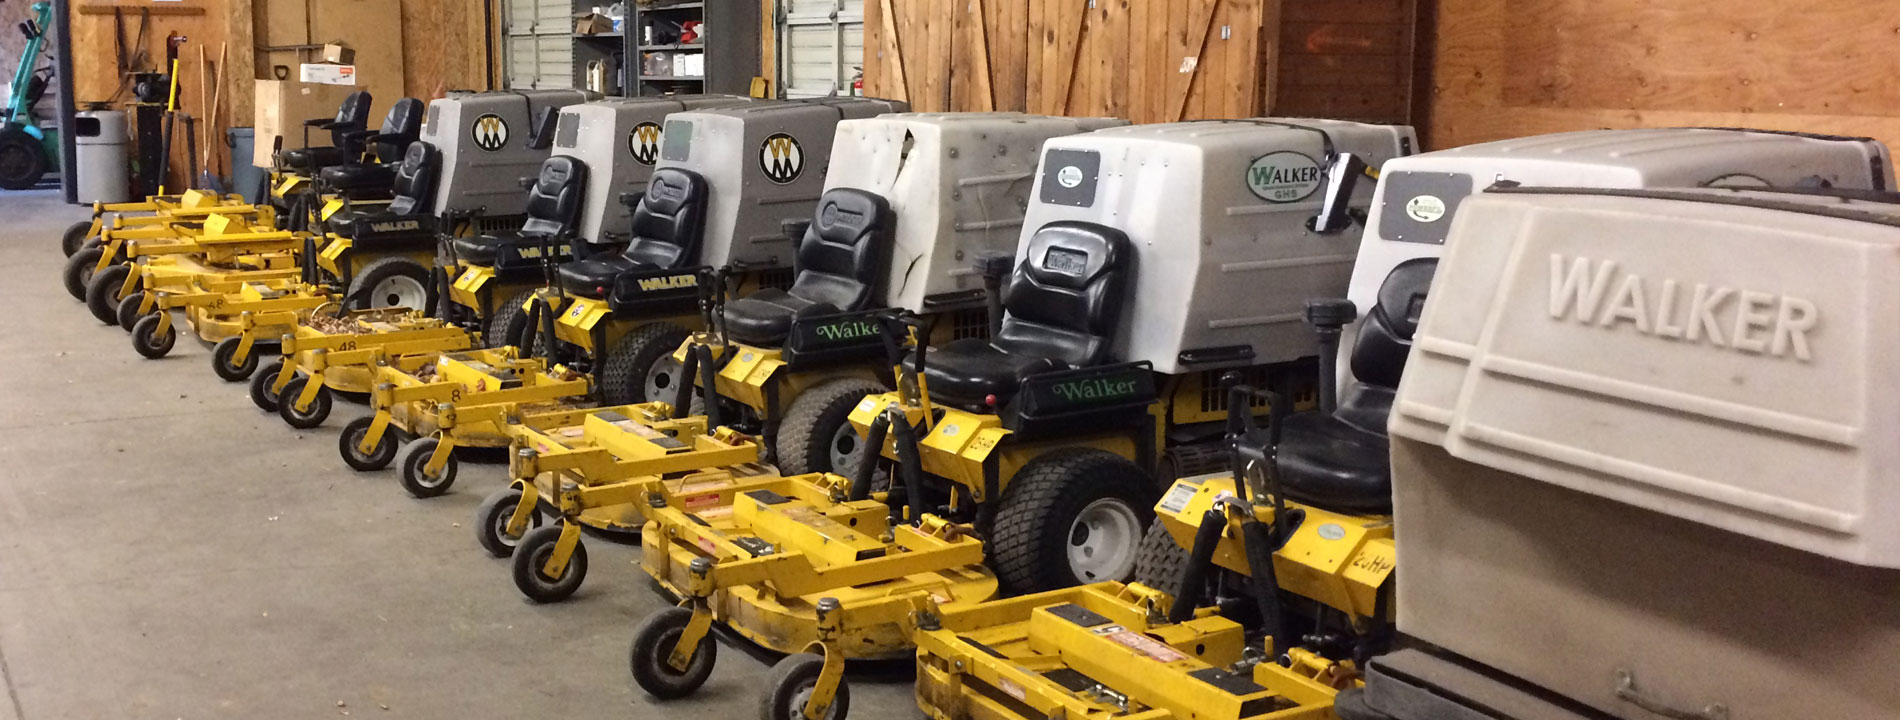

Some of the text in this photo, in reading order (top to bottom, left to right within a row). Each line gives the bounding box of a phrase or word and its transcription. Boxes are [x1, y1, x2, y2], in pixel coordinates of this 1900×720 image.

[1252, 166, 1318, 186] WALKER
[1275, 190, 1297, 199] GHS
[371, 220, 419, 232] WALKER
[637, 274, 698, 291] WALKER
[1549, 253, 1818, 361] WALKER
[816, 321, 880, 339] Walke
[1052, 379, 1136, 399] Walker
